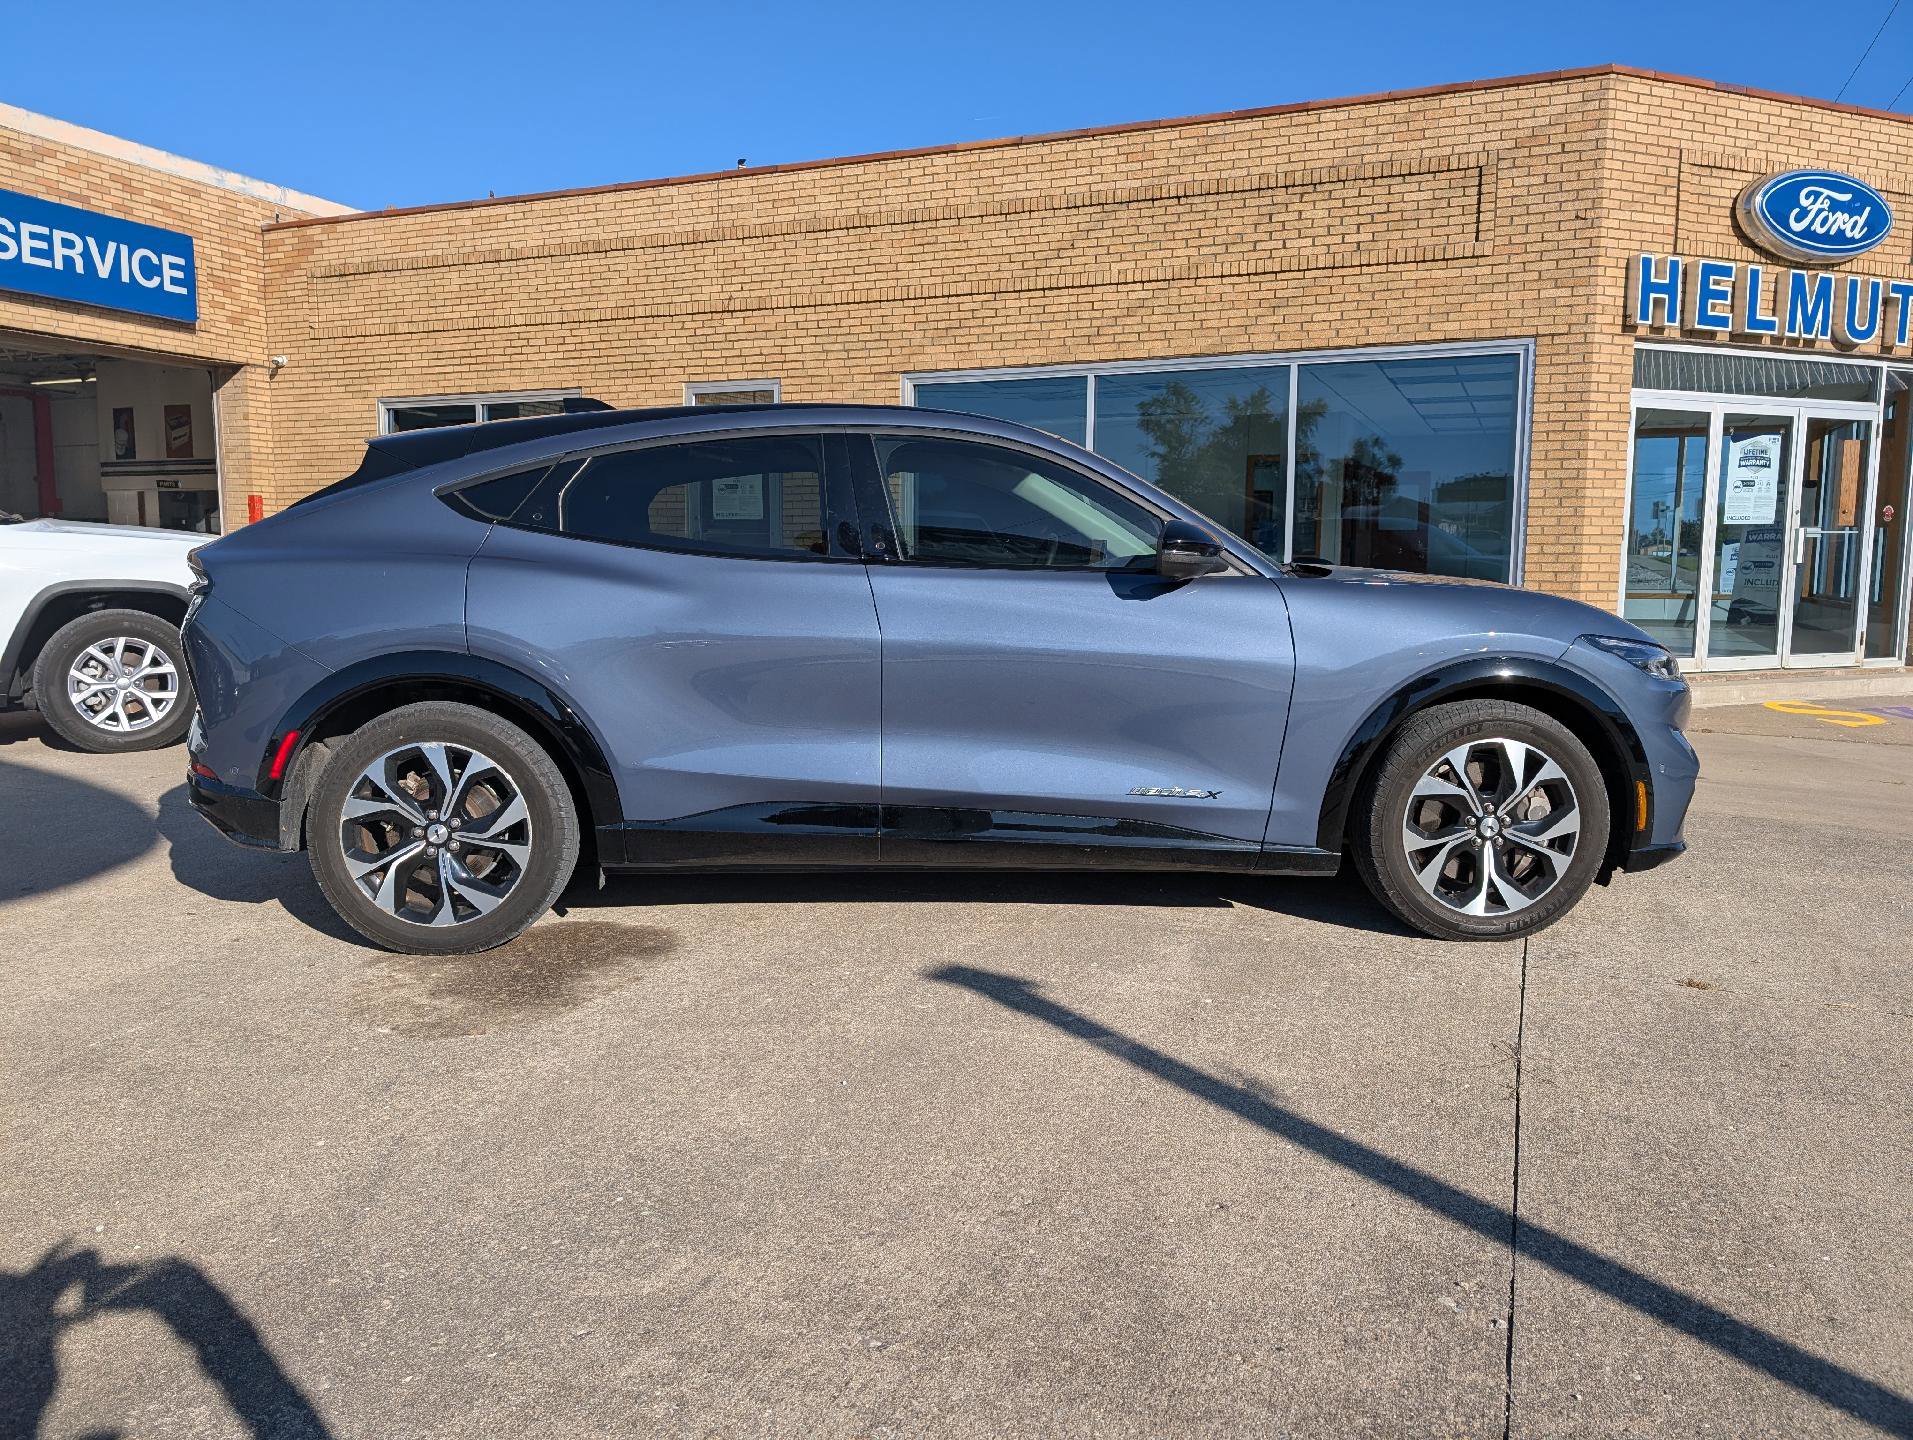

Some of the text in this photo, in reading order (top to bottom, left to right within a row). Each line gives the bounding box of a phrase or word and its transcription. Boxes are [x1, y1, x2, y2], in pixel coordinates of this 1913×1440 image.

[1789, 186, 1871, 239] Ford
[0, 217, 188, 295] SERVICE
[1637, 253, 1913, 346] HELMUT
[1740, 459, 1770, 467] WARRANTY
[1743, 448, 1768, 456] LIFETIME
